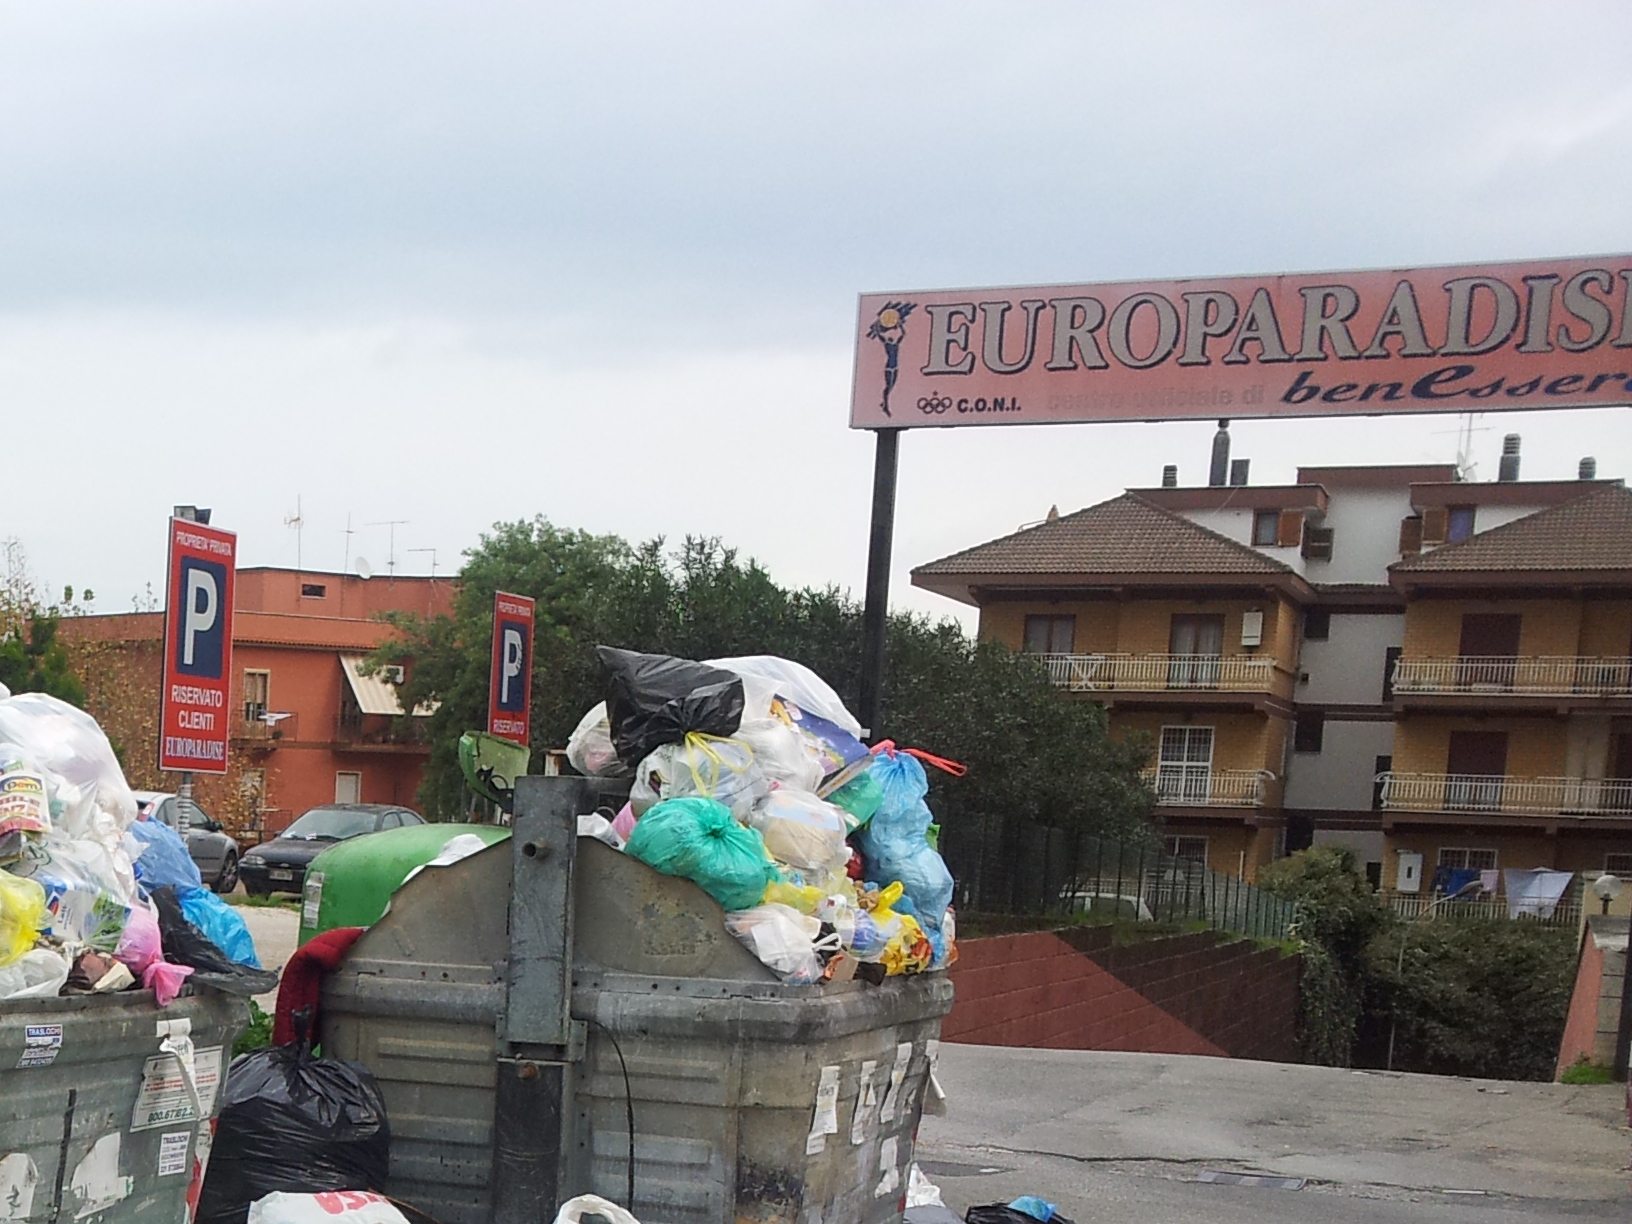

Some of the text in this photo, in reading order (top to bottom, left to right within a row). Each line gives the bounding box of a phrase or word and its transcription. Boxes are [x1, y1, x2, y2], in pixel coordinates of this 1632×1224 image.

[183, 567, 217, 666] P
[501, 629, 523, 703] P
[171, 685, 223, 707] RISERVATO
[178, 710, 215, 731] CLIENTI
[494, 719, 525, 734] RISERVATO
[165, 736, 225, 760] EUROPARADISE
[28, 1028, 62, 1036] TRASLOCHI
